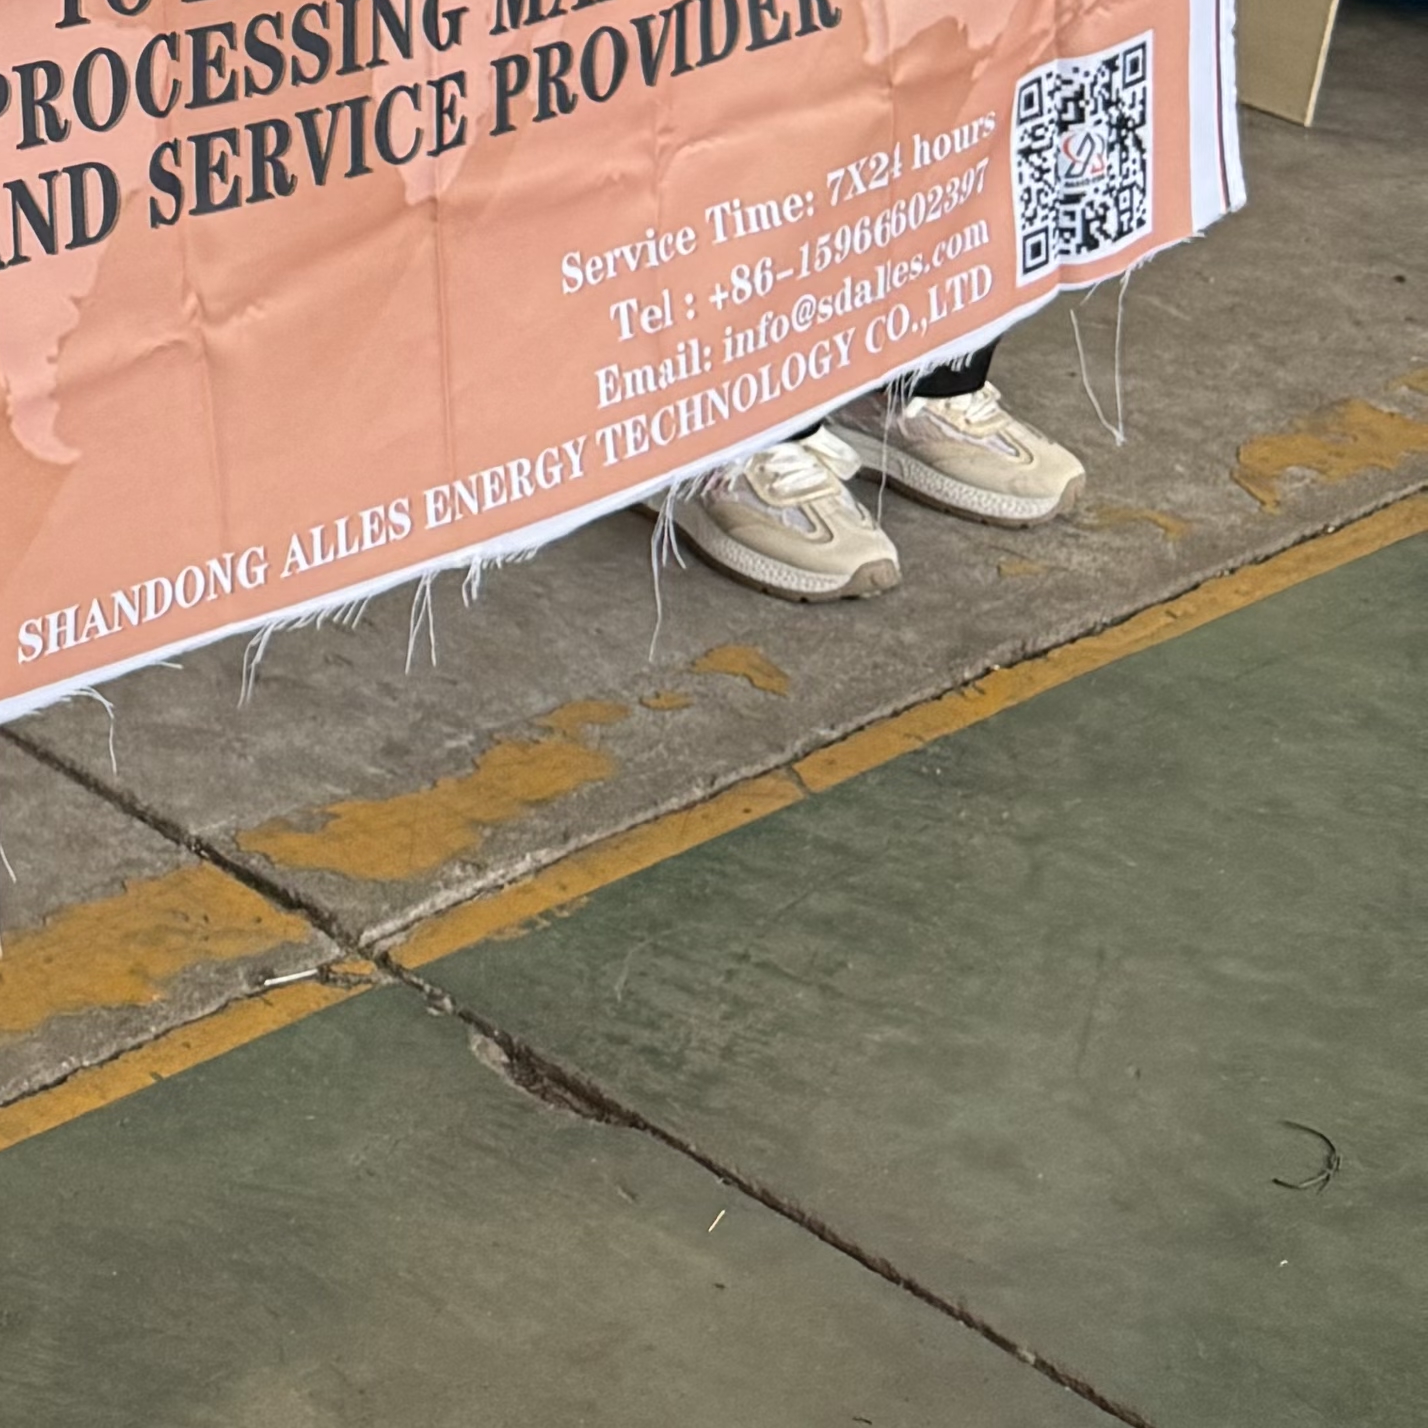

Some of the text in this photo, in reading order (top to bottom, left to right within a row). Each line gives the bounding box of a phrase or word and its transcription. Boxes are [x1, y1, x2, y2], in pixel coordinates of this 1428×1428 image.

[148, 69, 468, 229] SERVICE
[561, 228, 696, 294] Service
[705, 189, 816, 245] Time:
[911, 110, 997, 170] hours
[594, 219, 990, 409] Email: info@sdalles.com
[609, 289, 674, 342] Tel
[17, 263, 994, 664] SHANDONG ALLES ENERGY TECHNOLOGY CO.,LTD
